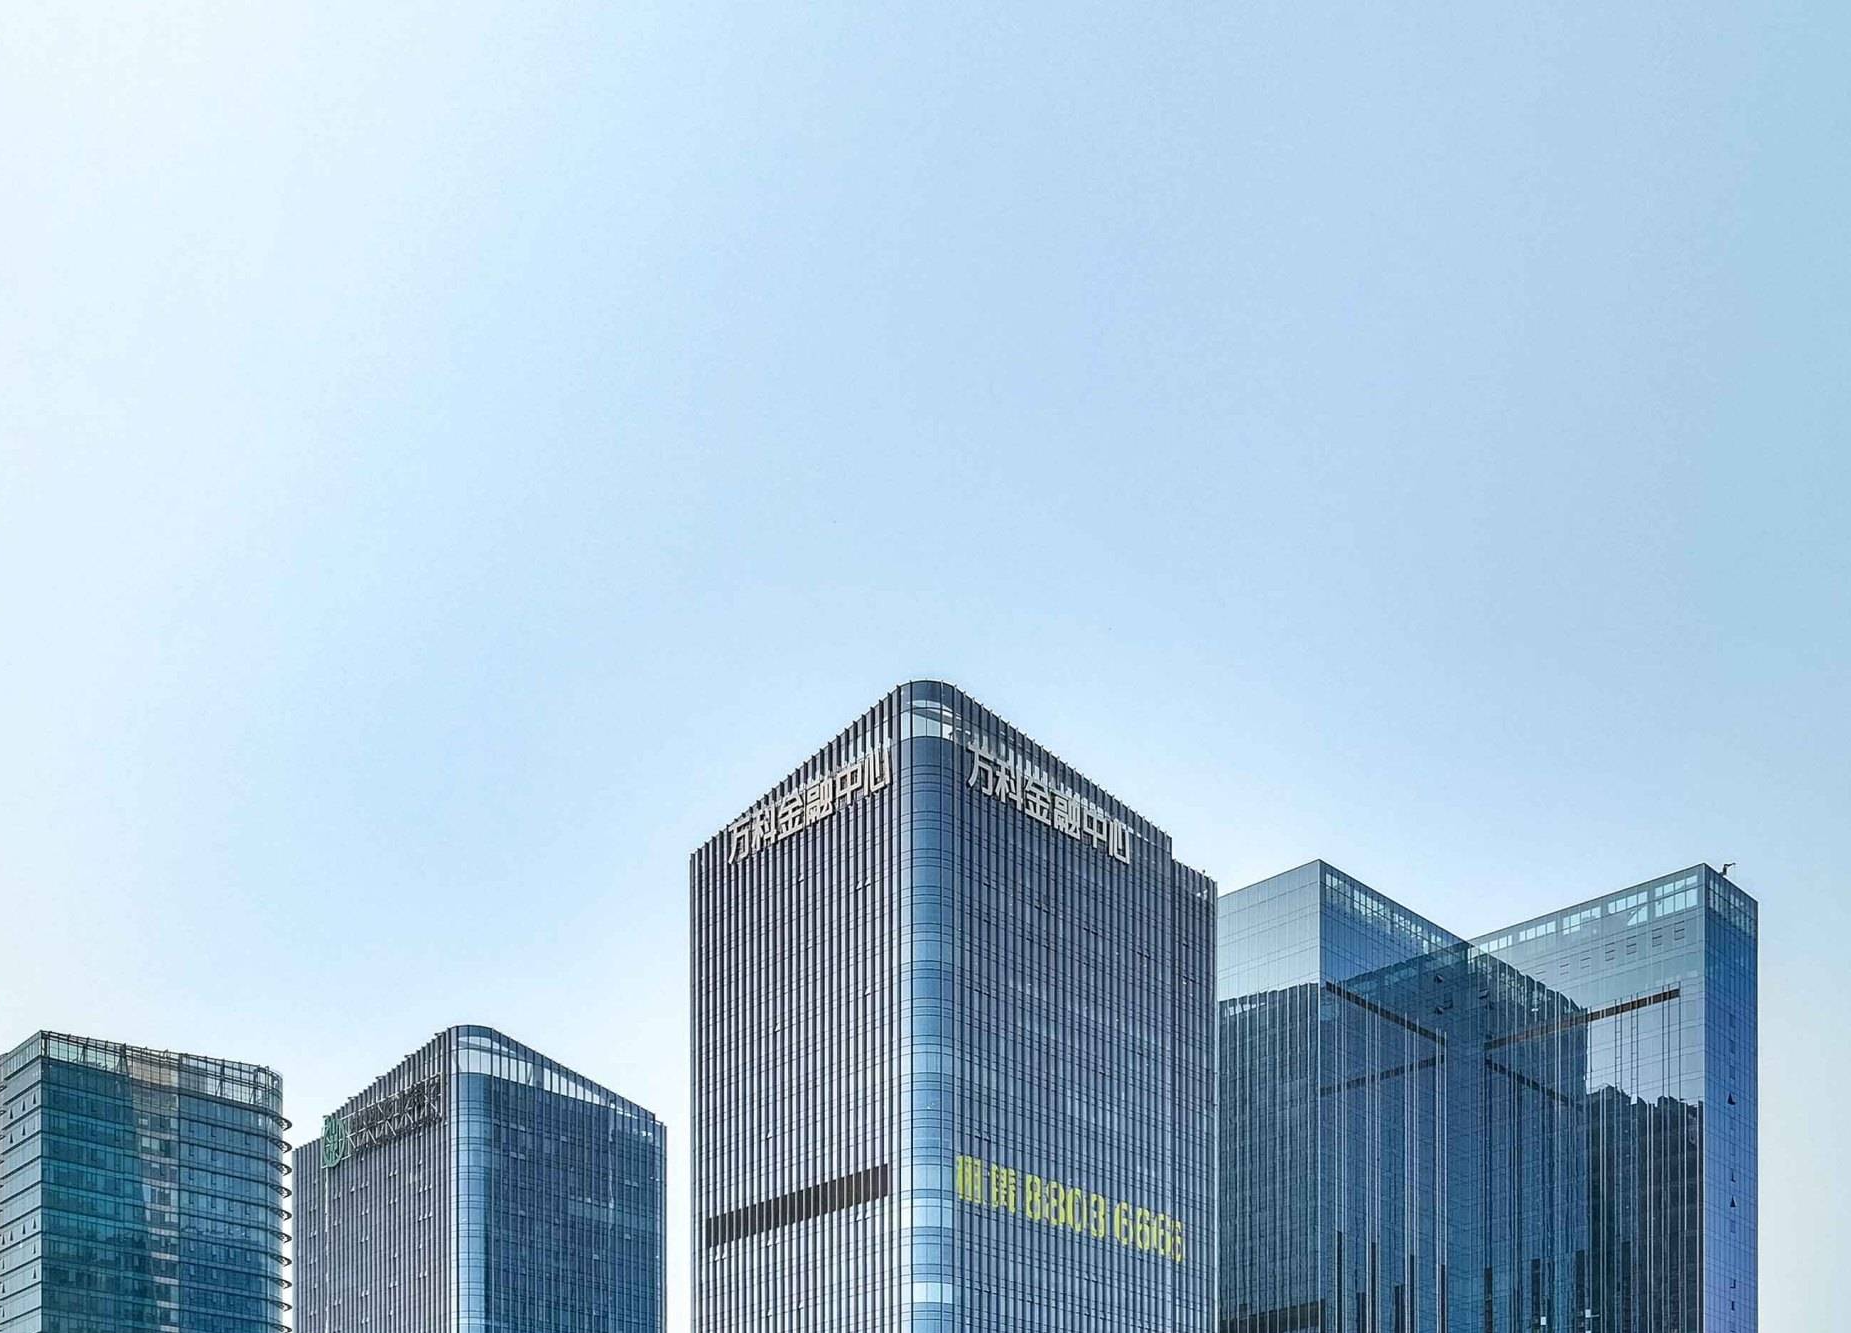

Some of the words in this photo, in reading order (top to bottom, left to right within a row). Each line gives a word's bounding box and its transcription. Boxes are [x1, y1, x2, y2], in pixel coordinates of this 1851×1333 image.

[727, 740, 893, 865] 万科金融中心
[966, 741, 1131, 864] 万科金融中心
